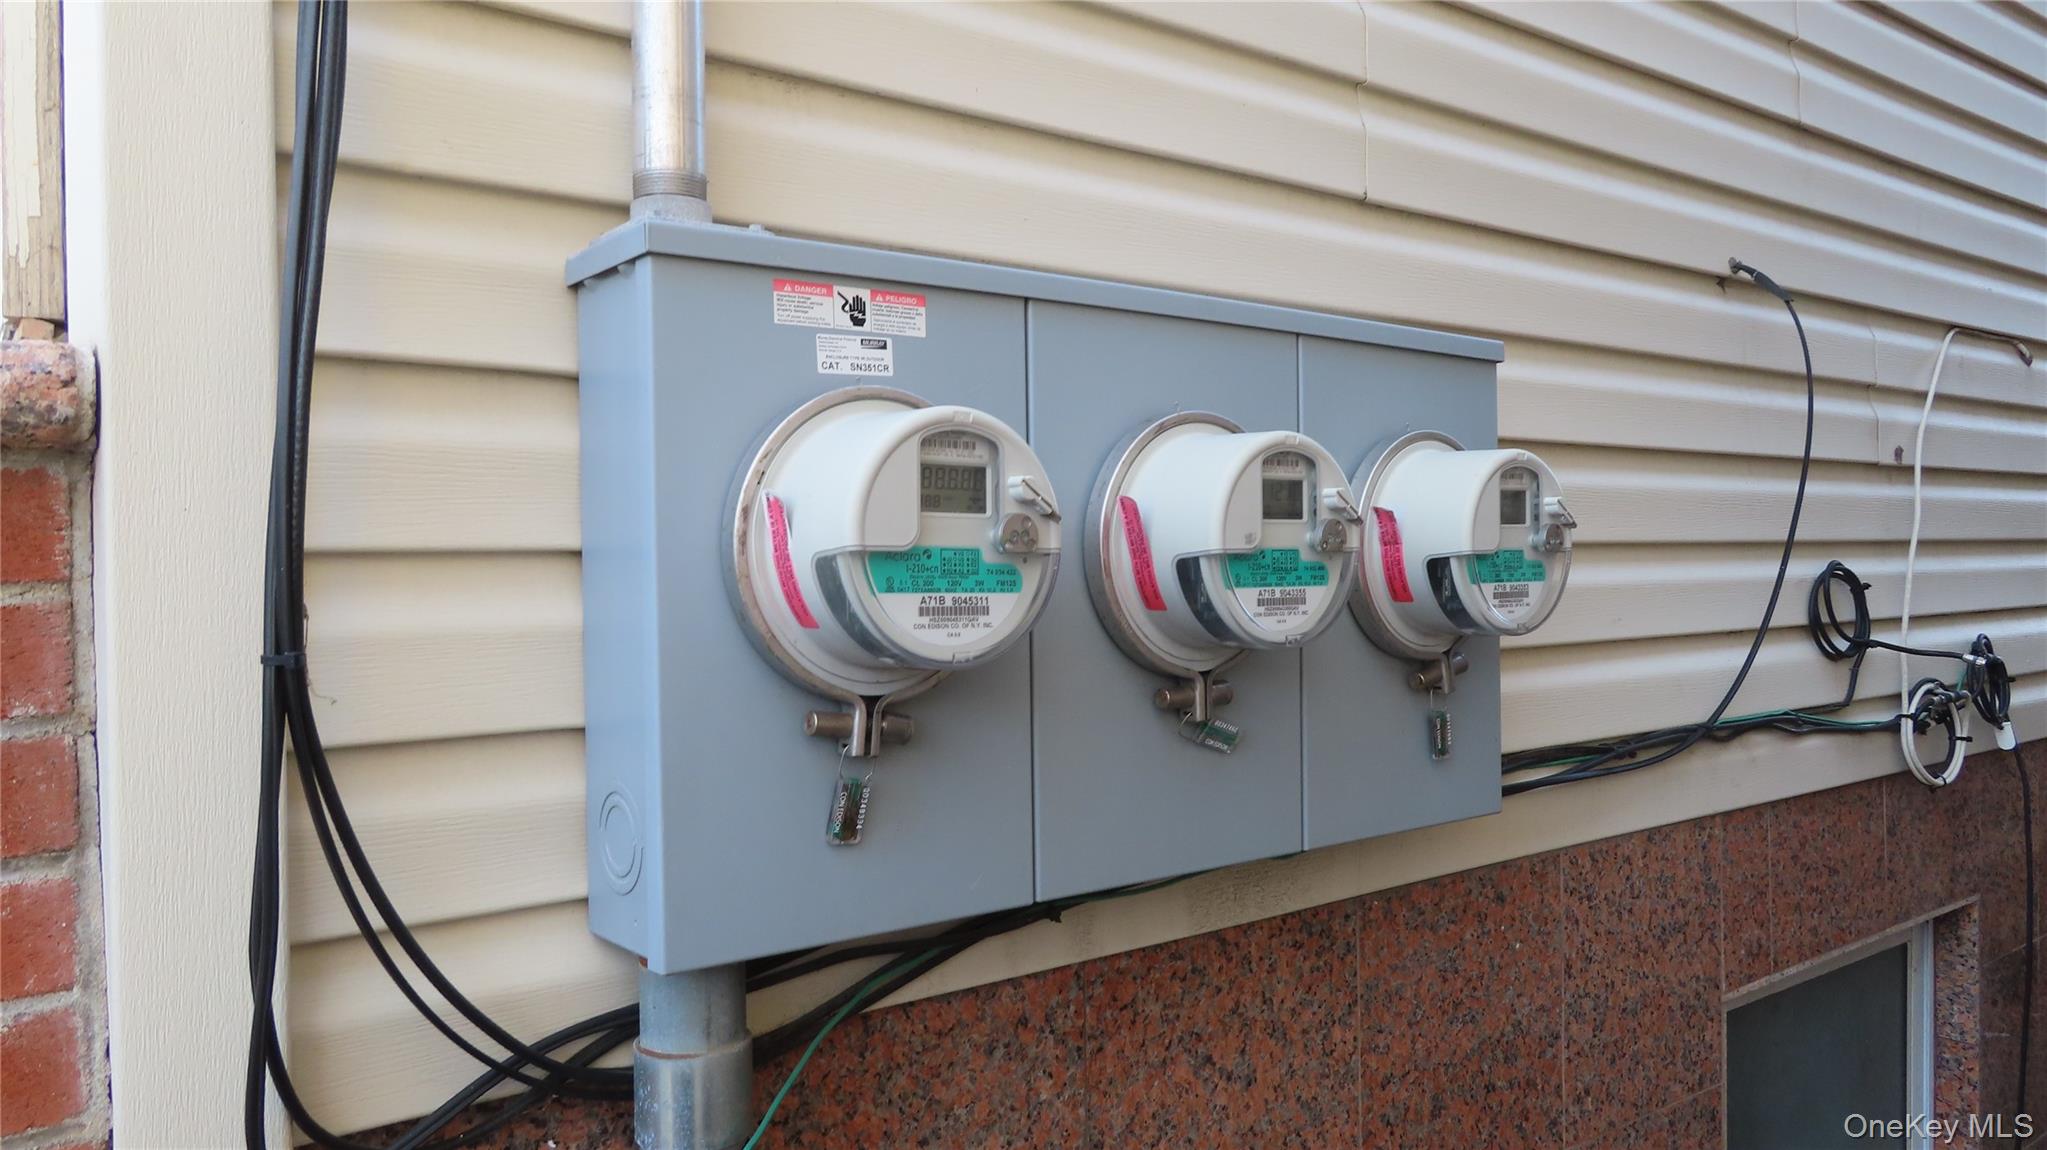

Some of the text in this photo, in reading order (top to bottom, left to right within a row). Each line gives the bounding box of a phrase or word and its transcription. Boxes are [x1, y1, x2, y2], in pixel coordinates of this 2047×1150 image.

[794, 284, 827, 294] DANGER
[885, 295, 917, 305] PELIGRO
[821, 361, 843, 370] CAT.
[920, 595, 989, 606] A71B 9045311
[927, 622, 950, 630] EDISON
